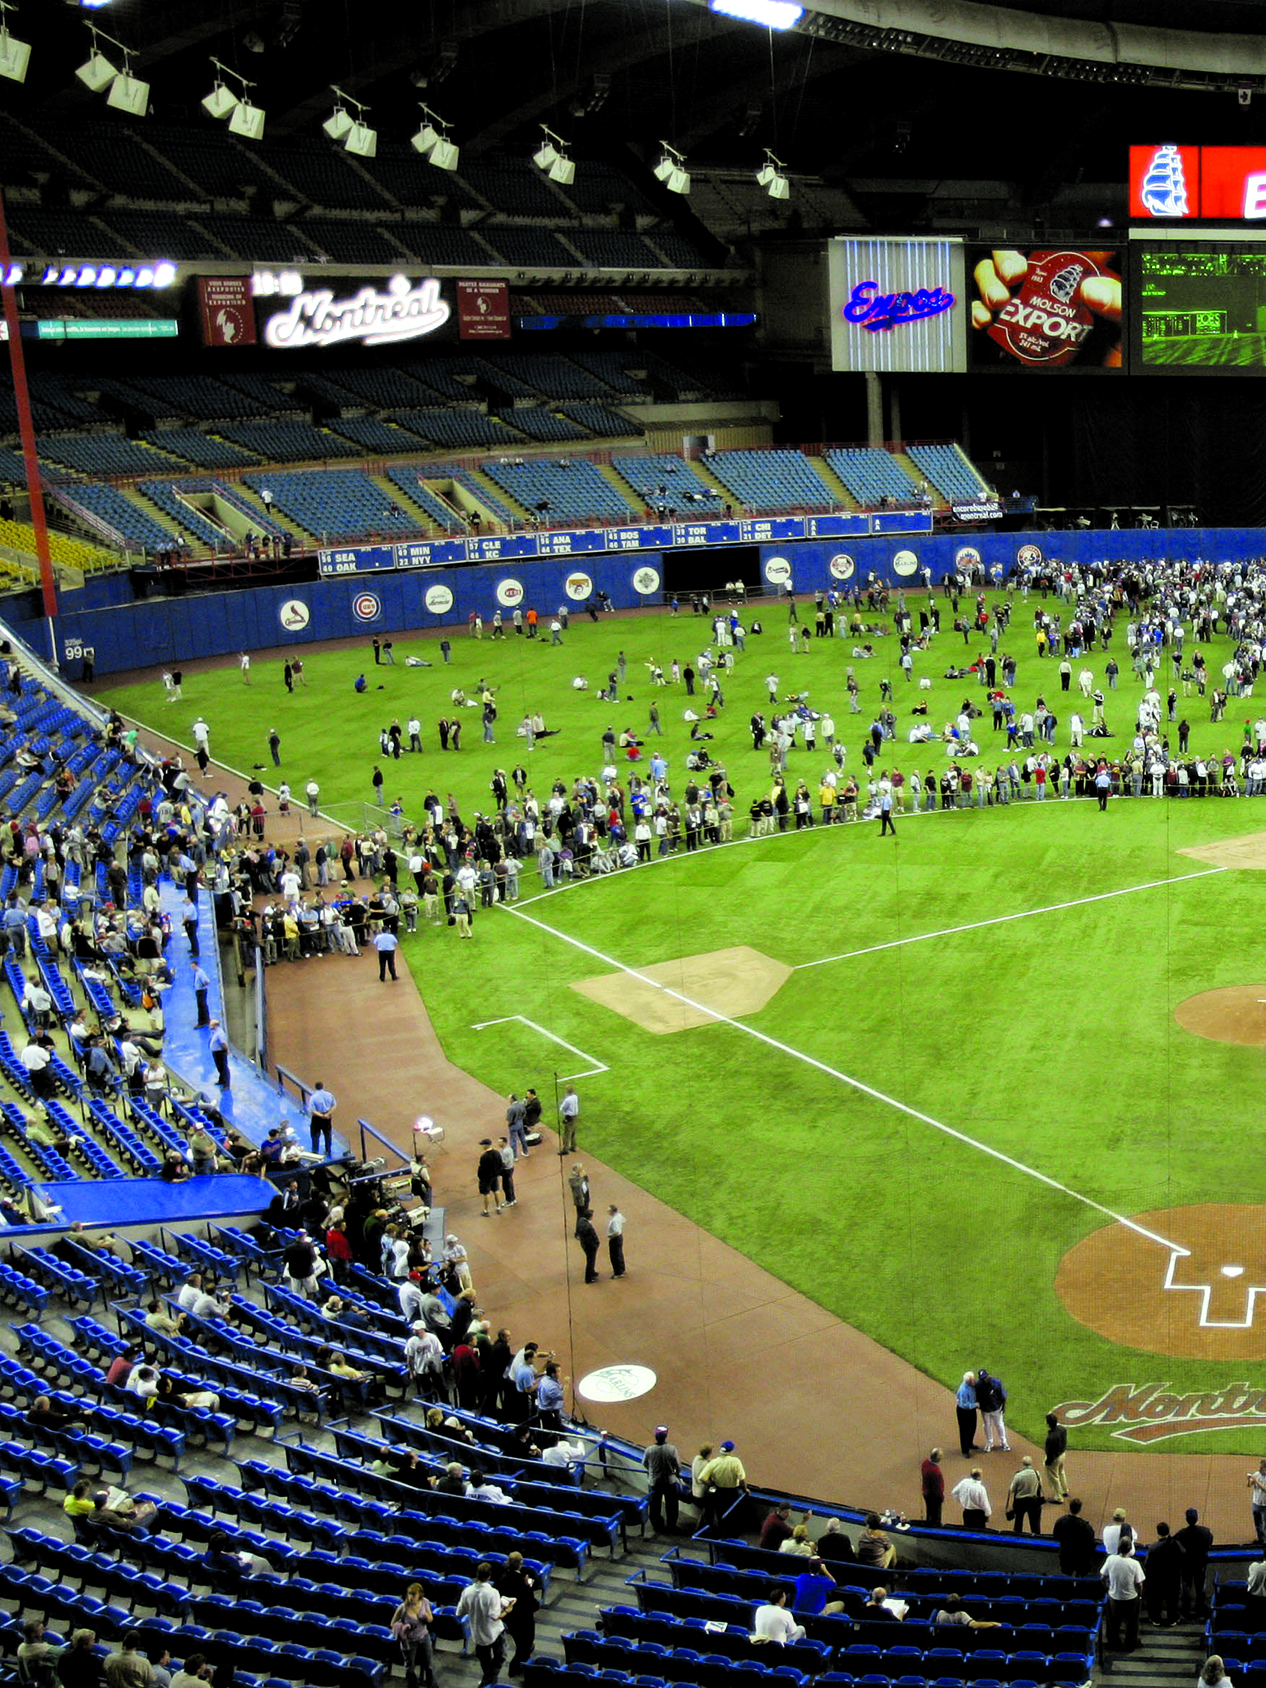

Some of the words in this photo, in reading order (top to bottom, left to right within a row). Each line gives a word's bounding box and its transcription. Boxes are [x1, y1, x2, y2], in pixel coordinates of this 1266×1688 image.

[844, 280, 955, 331] Expos
[1030, 296, 1076, 318] MOLSON
[1000, 299, 1093, 342] EXPORT
[688, 527, 706, 535] TOR
[755, 523, 771, 531] CHI
[620, 531, 639, 539] BOS
[553, 536, 571, 544] ANA
[622, 540, 639, 548] TAM
[688, 536, 707, 544] BAL
[482, 541, 501, 549] CLE
[553, 545, 572, 553] TEX
[410, 547, 430, 556] MIN
[485, 550, 499, 558] KC
[335, 553, 356, 562] SEA
[399, 558, 409, 566] 22
[412, 556, 431, 565] NYY
[336, 563, 357, 571] OAK
